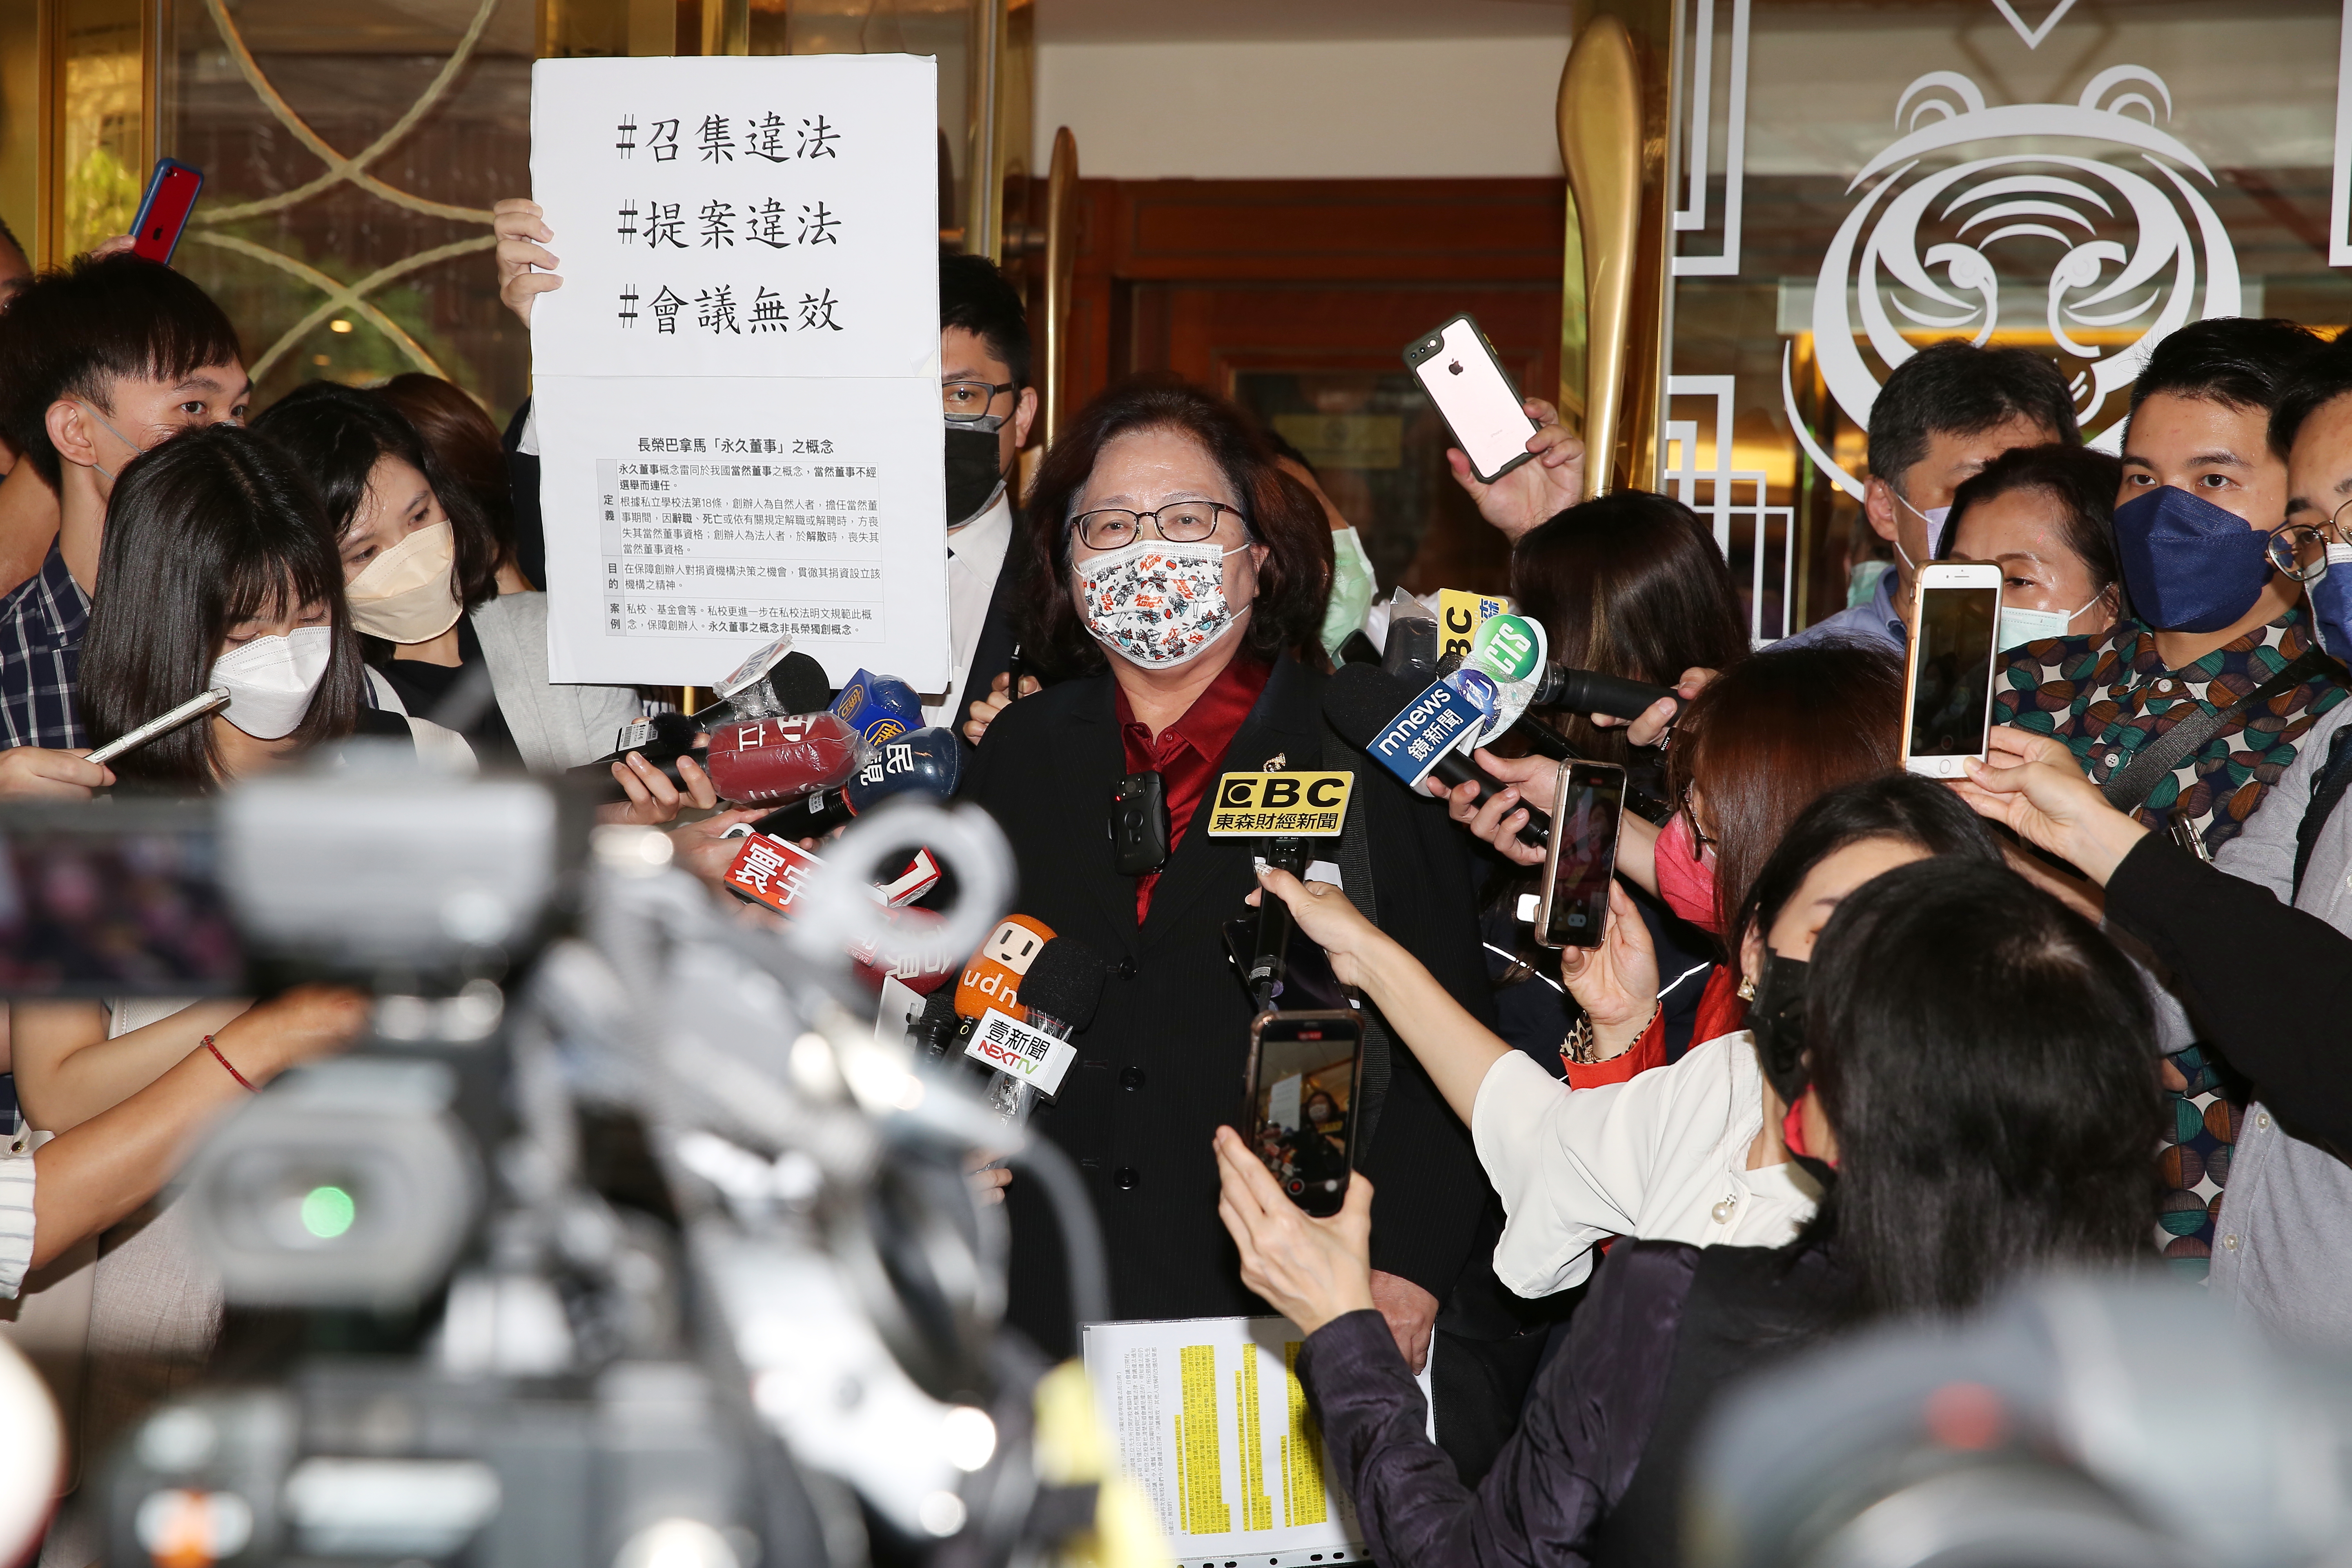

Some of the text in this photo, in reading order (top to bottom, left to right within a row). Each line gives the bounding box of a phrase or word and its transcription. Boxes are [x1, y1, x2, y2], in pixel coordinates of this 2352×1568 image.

[616, 111, 842, 164] #召集違法
[617, 197, 842, 249] #提案違法
[618, 283, 844, 335] #會議無效
[638, 437, 834, 454] 長榮巴拿馬「永久董事」之概念
[618, 463, 877, 478] 永久董事概念雷同於我國當然董事之概念，當然董事不經
[619, 479, 678, 491] 選舉而連任。
[604, 494, 615, 521] 定義
[623, 543, 691, 555] 當然董事資格。
[608, 563, 619, 589] 目的
[625, 579, 683, 591] 機構之精神。
[610, 603, 621, 630] 案例
[1446, 606, 1472, 657] BC
[1483, 622, 1532, 675] CTS
[1378, 688, 1452, 757] mnews
[1407, 708, 1464, 763] 鏡新聞
[1660, 736, 1670, 751] SONY
[1219, 778, 1345, 808] EBC
[1213, 812, 1339, 831] 東森財經新聞
[851, 949, 870, 964] NEWS
[963, 969, 1018, 1009] udn
[984, 1018, 1051, 1062] 壹新聞
